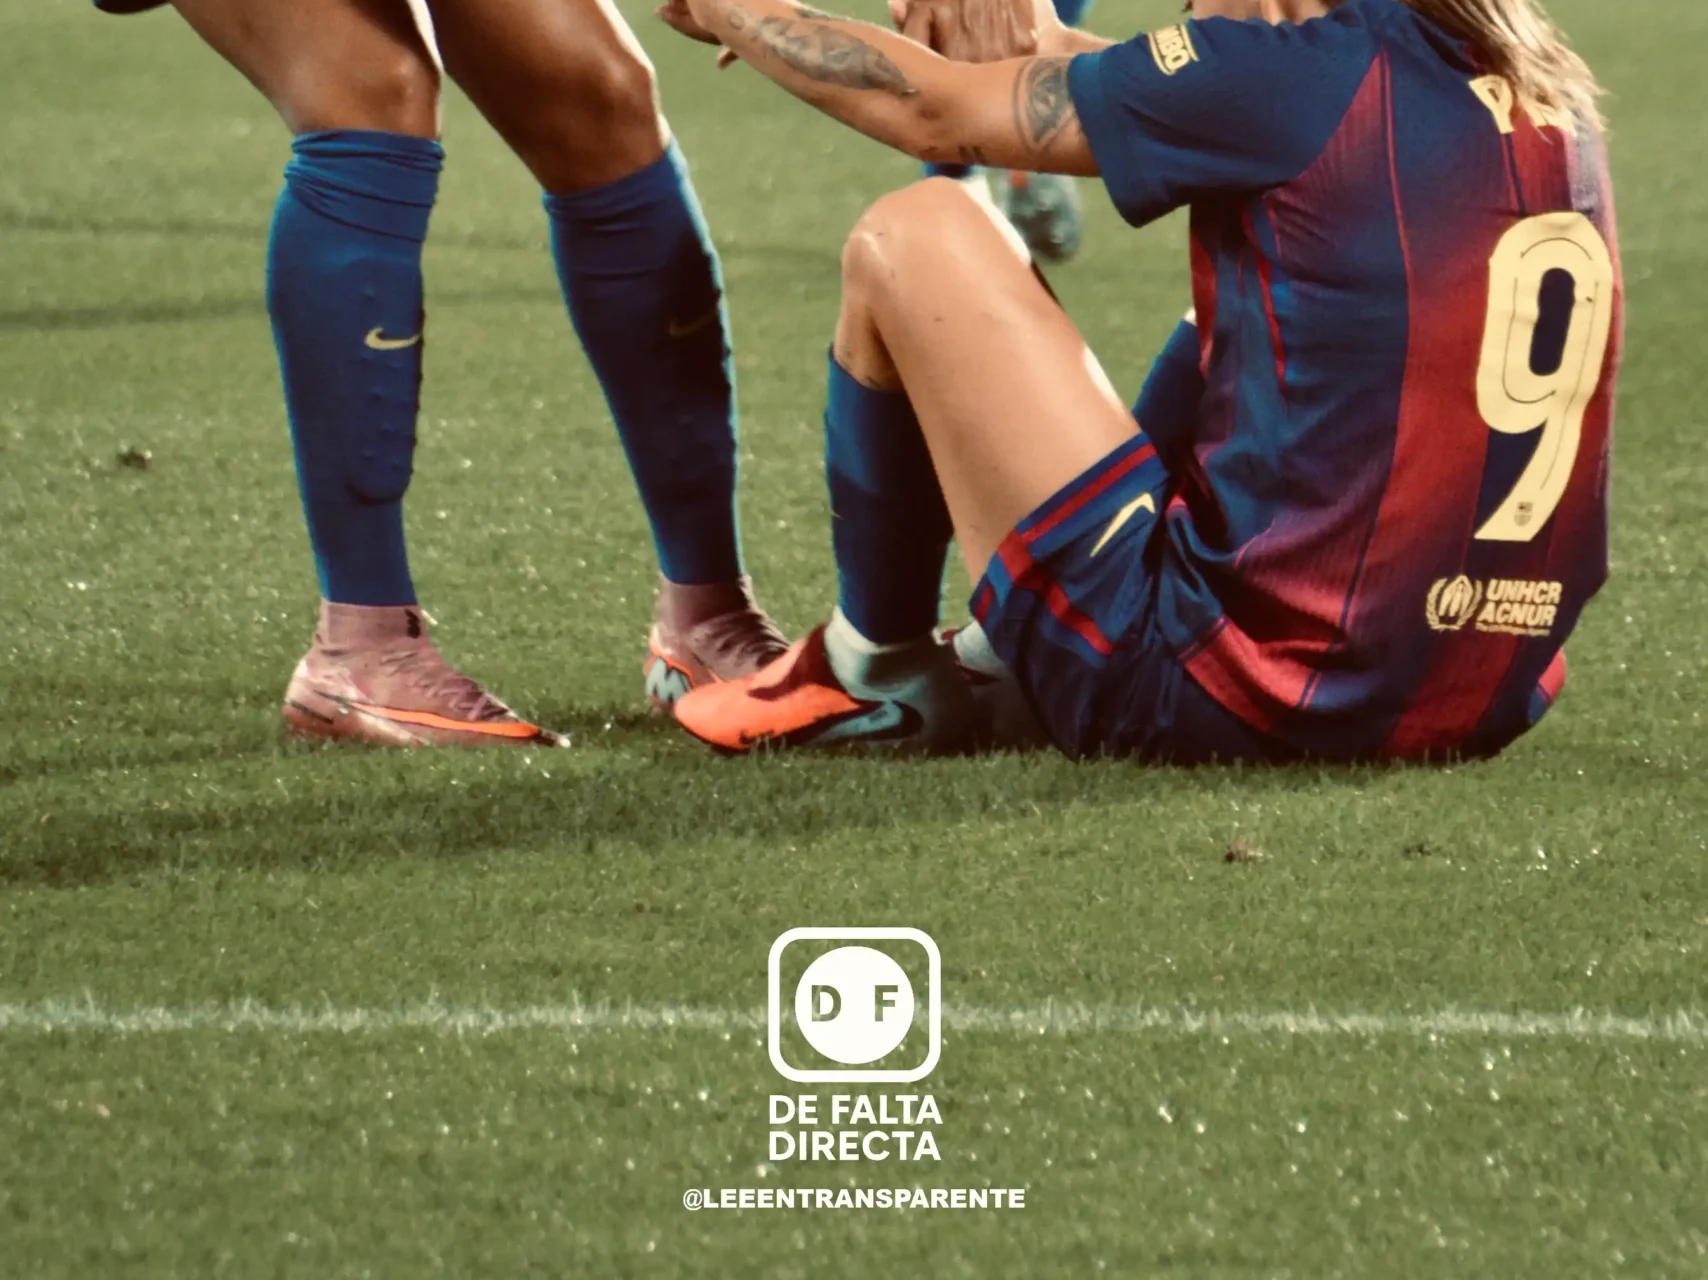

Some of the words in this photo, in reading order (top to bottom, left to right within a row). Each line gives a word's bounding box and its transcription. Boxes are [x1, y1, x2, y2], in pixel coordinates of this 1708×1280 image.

[1475, 212, 1613, 541] 9
[1486, 578, 1562, 604] UNHCR
[1476, 601, 1557, 626] ACNUR
